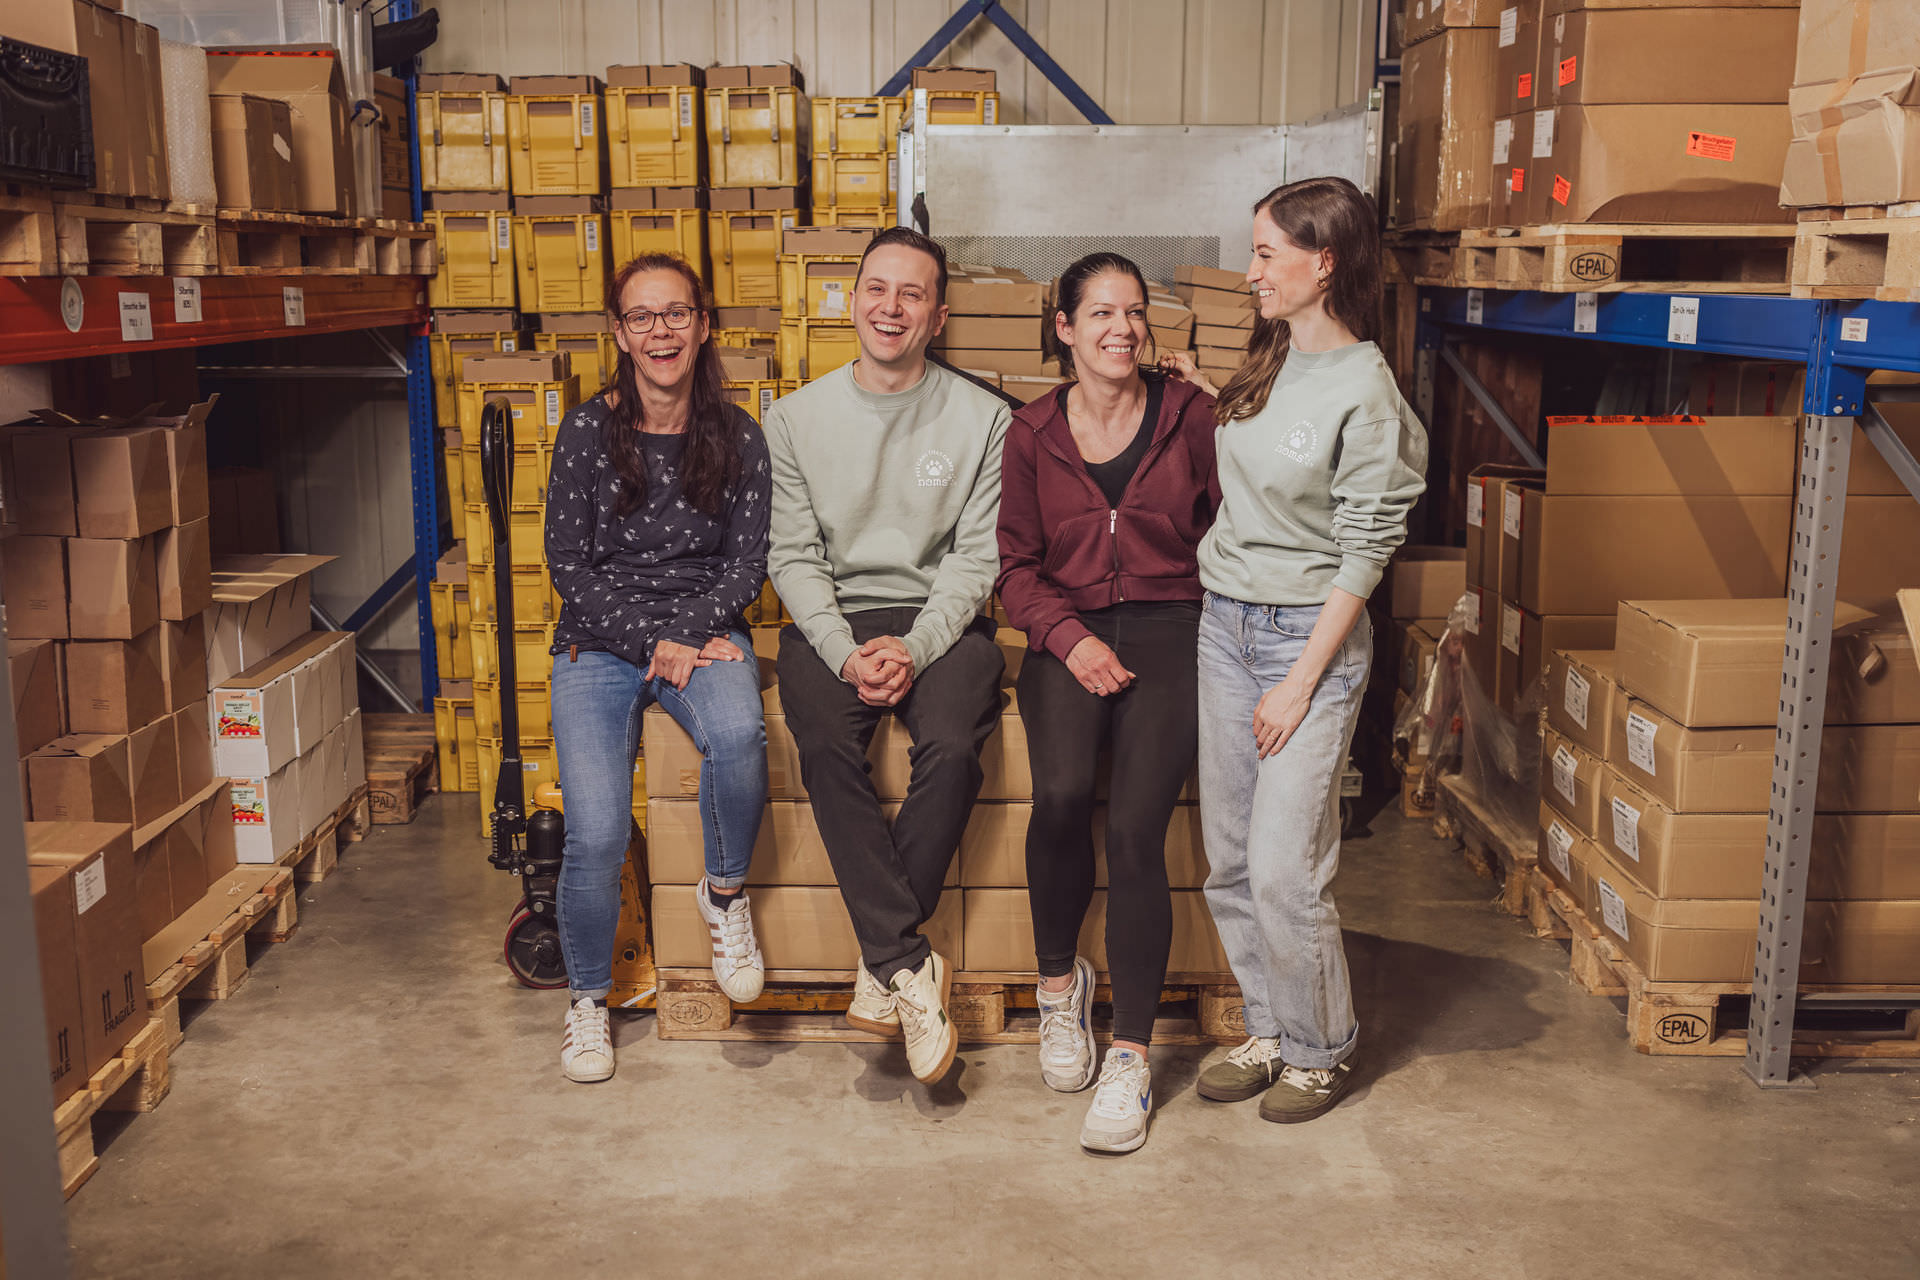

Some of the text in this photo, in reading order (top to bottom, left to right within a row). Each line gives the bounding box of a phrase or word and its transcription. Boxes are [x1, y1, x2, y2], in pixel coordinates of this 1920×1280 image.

[1576, 258, 1609, 275] EPAL
[104, 999, 137, 1037] FRAGILE
[1228, 1011, 1246, 1025] EP
[1662, 1020, 1700, 1038] EPAL
